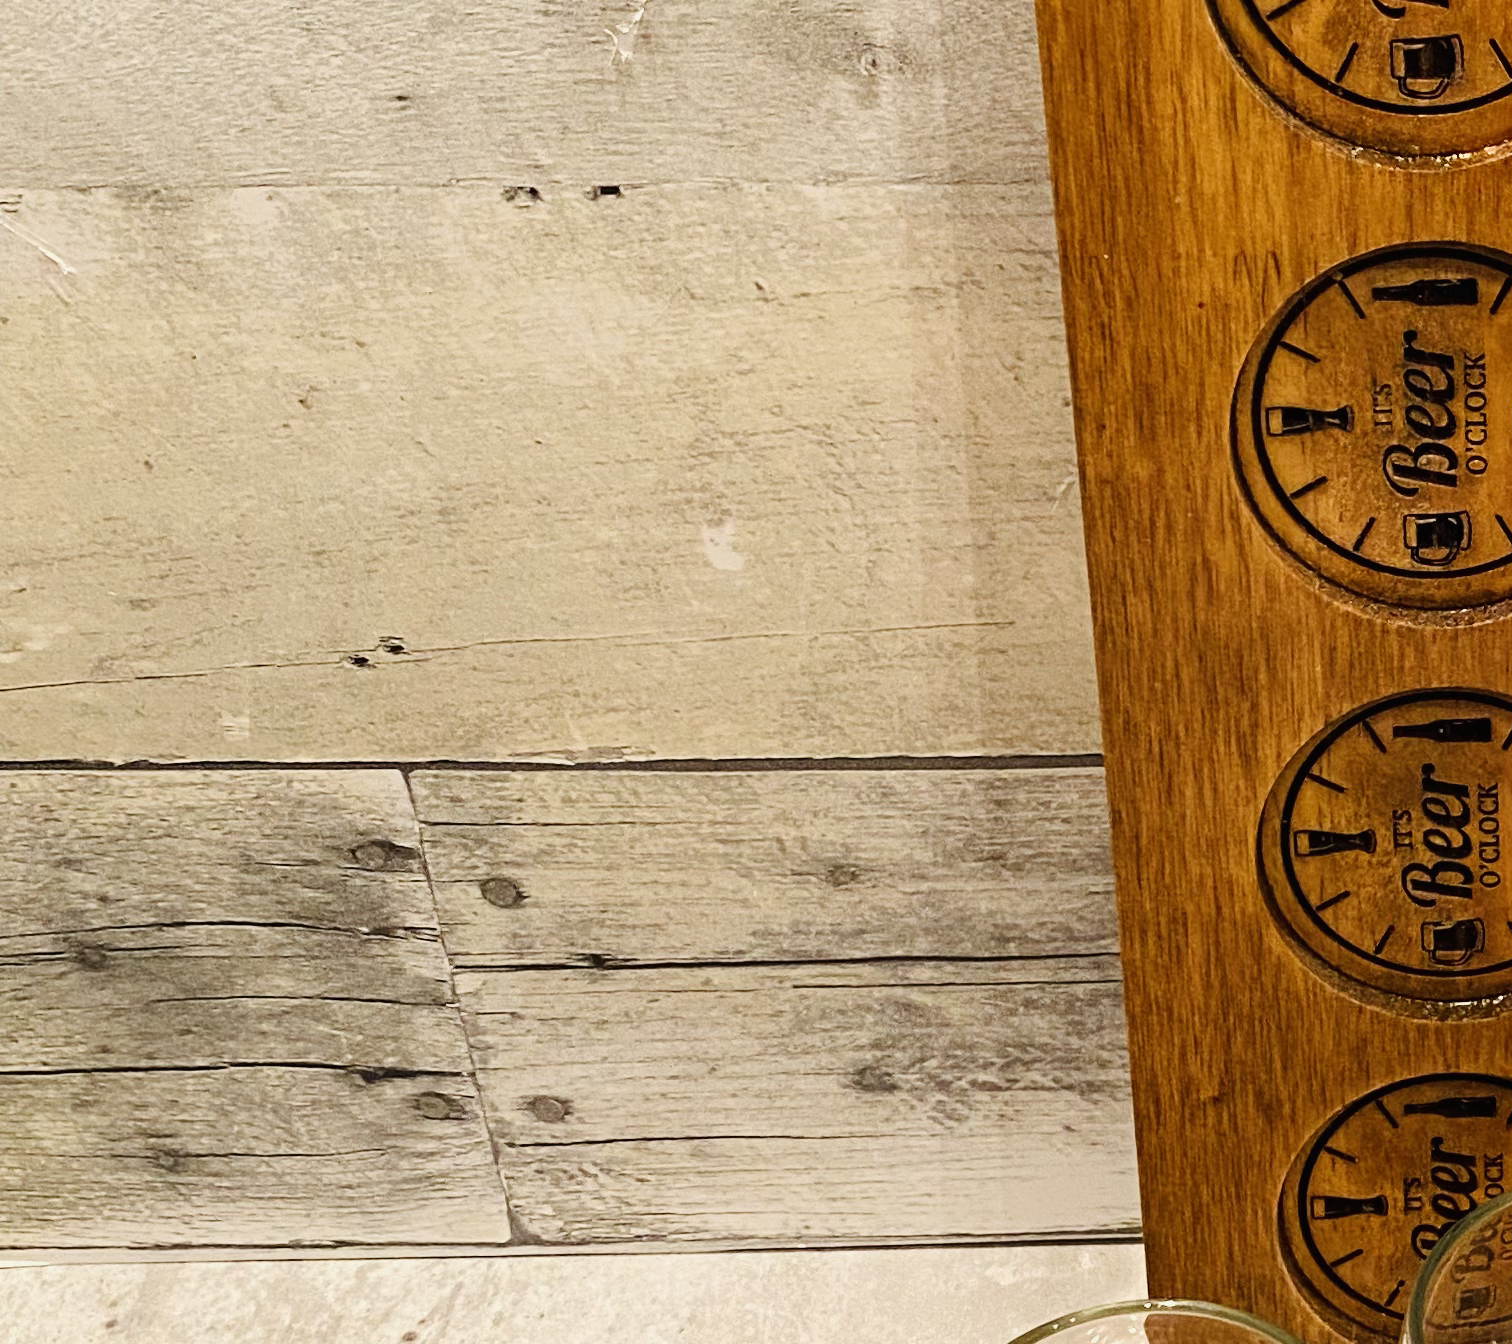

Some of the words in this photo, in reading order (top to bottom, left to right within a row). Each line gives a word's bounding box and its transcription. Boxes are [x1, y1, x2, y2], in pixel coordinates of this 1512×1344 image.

[1372, 382, 1394, 431] IT'S
[1383, 329, 1459, 497] Beer
[1463, 352, 1490, 477] O'CLOCK
[1392, 807, 1413, 856] IT'S
[1400, 762, 1474, 908] Beer
[1477, 781, 1502, 890] O'CLOCK
